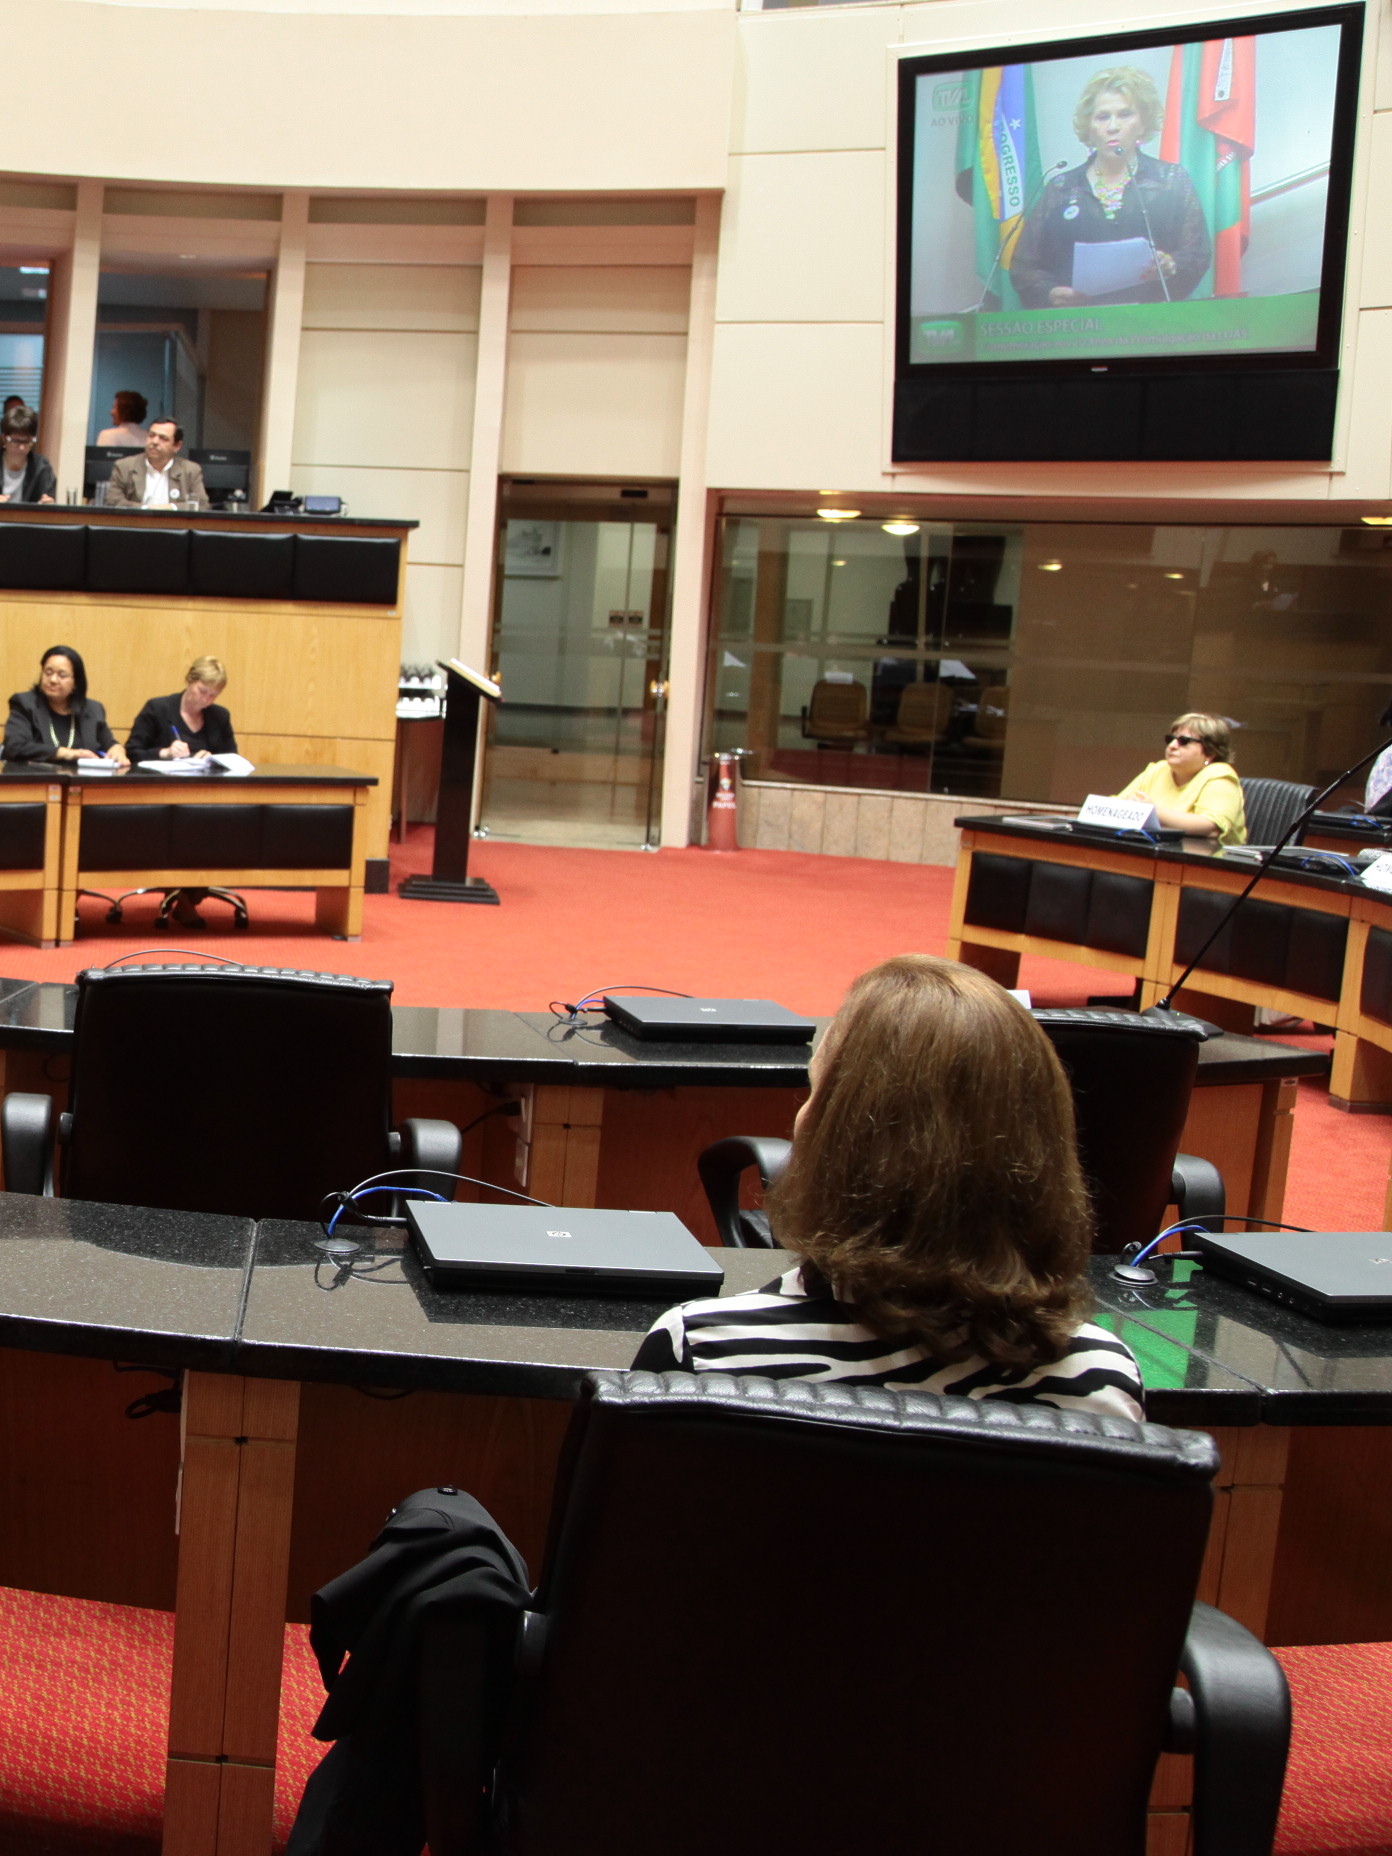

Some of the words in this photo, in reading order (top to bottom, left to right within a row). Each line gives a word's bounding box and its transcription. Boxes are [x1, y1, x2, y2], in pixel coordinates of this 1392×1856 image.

[930, 117, 946, 128] AO
[947, 114, 974, 126] VIVO
[1037, 318, 1104, 334] ESPECIAL
